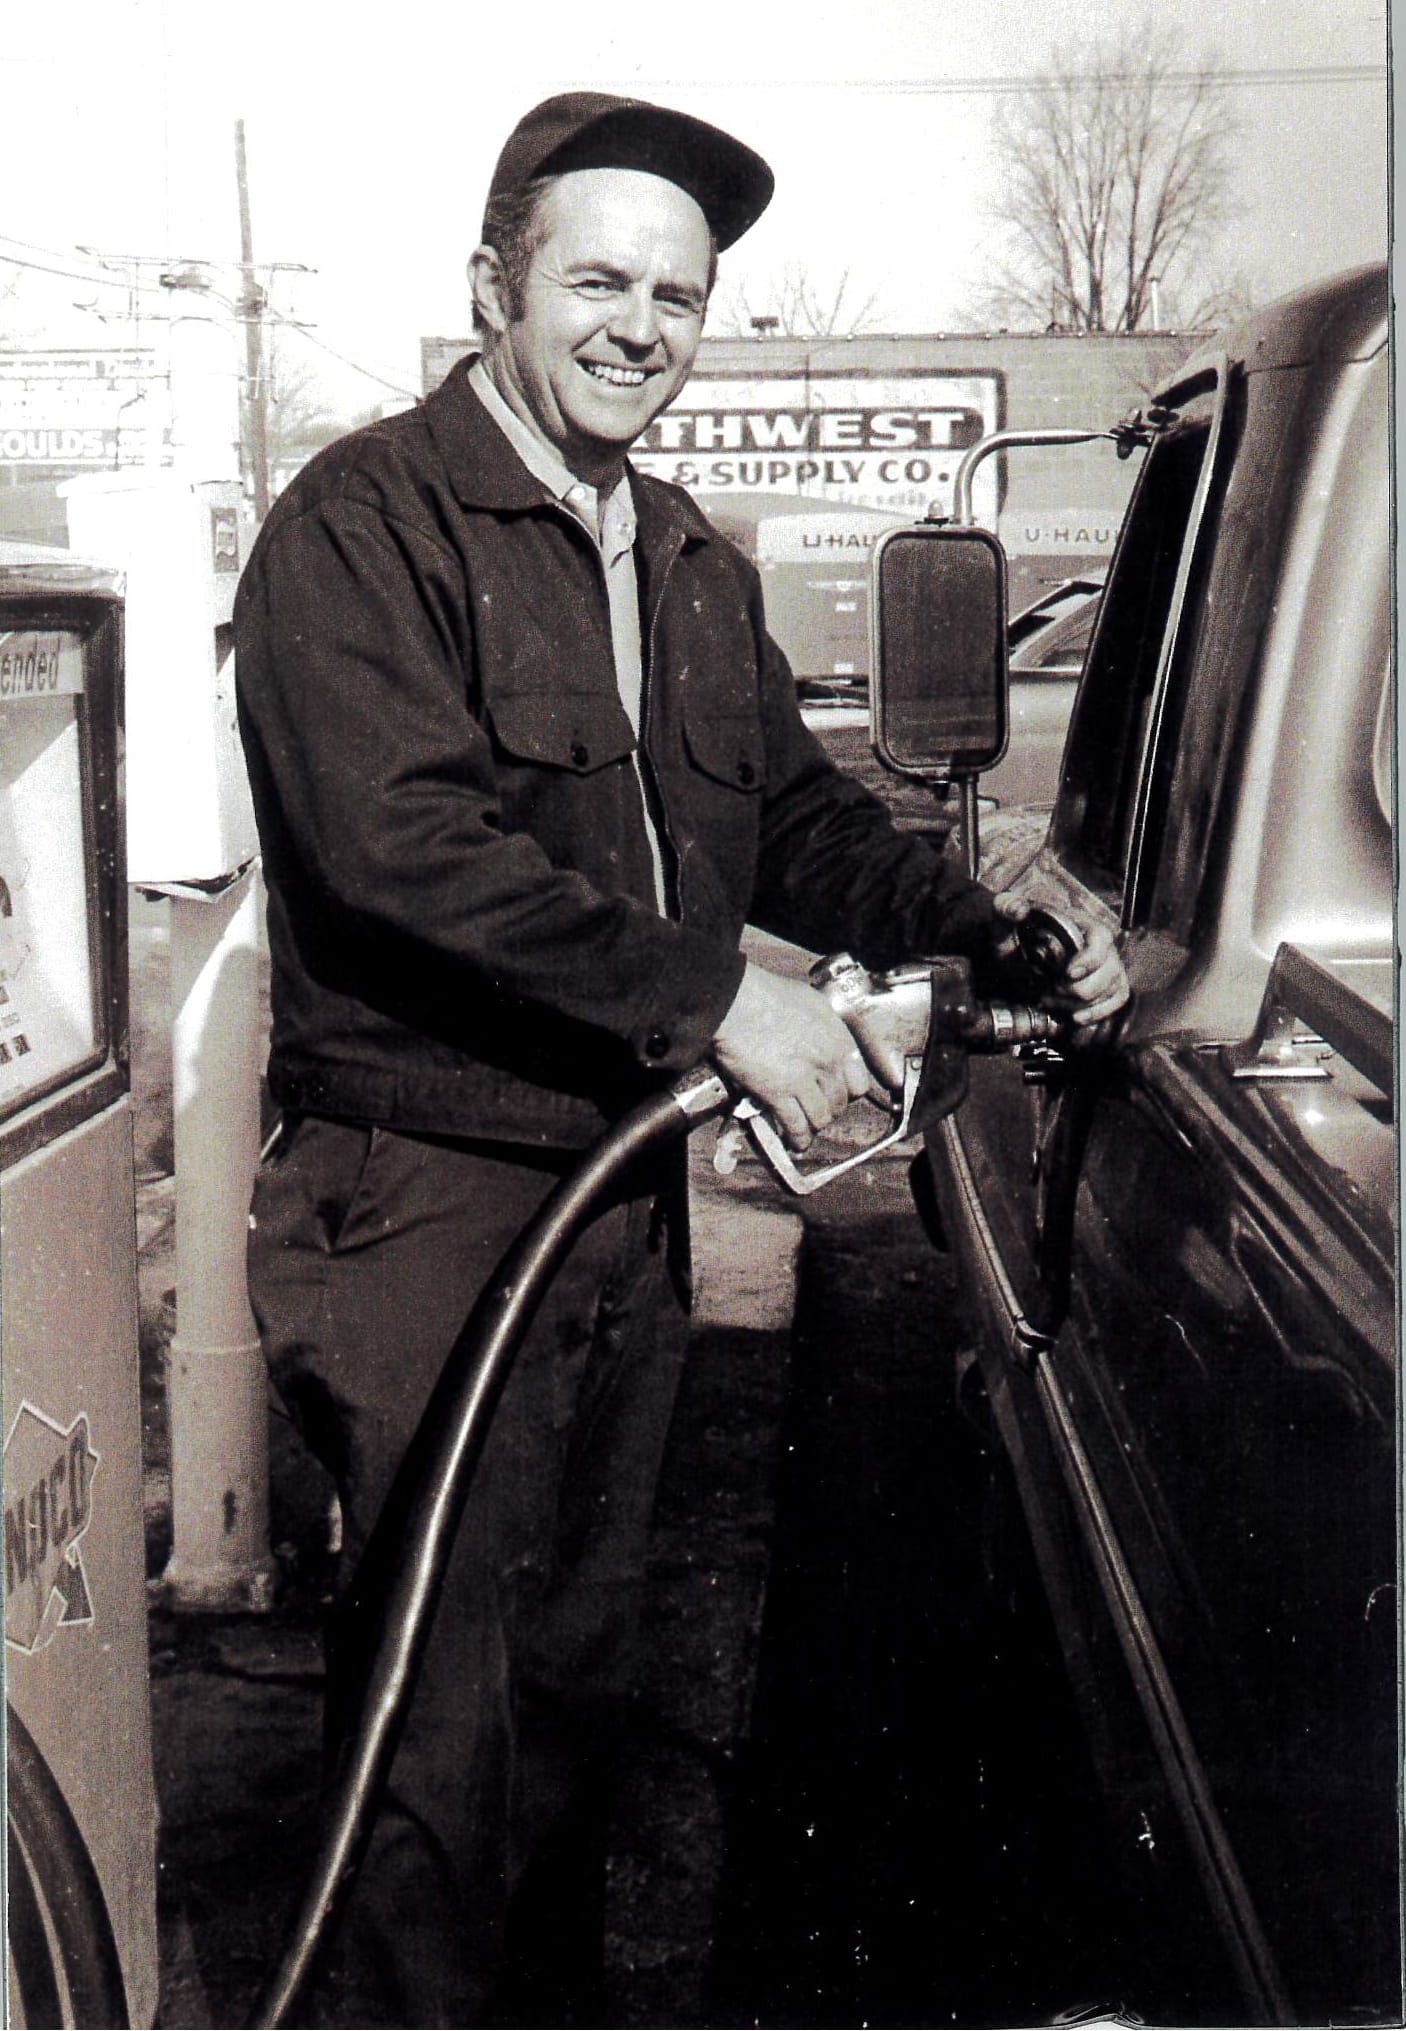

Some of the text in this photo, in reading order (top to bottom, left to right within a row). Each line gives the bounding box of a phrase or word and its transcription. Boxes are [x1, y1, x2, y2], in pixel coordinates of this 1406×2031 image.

[671, 461, 700, 485] &
[708, 460, 866, 485] SUPPLY
[877, 459, 949, 484] CO.
